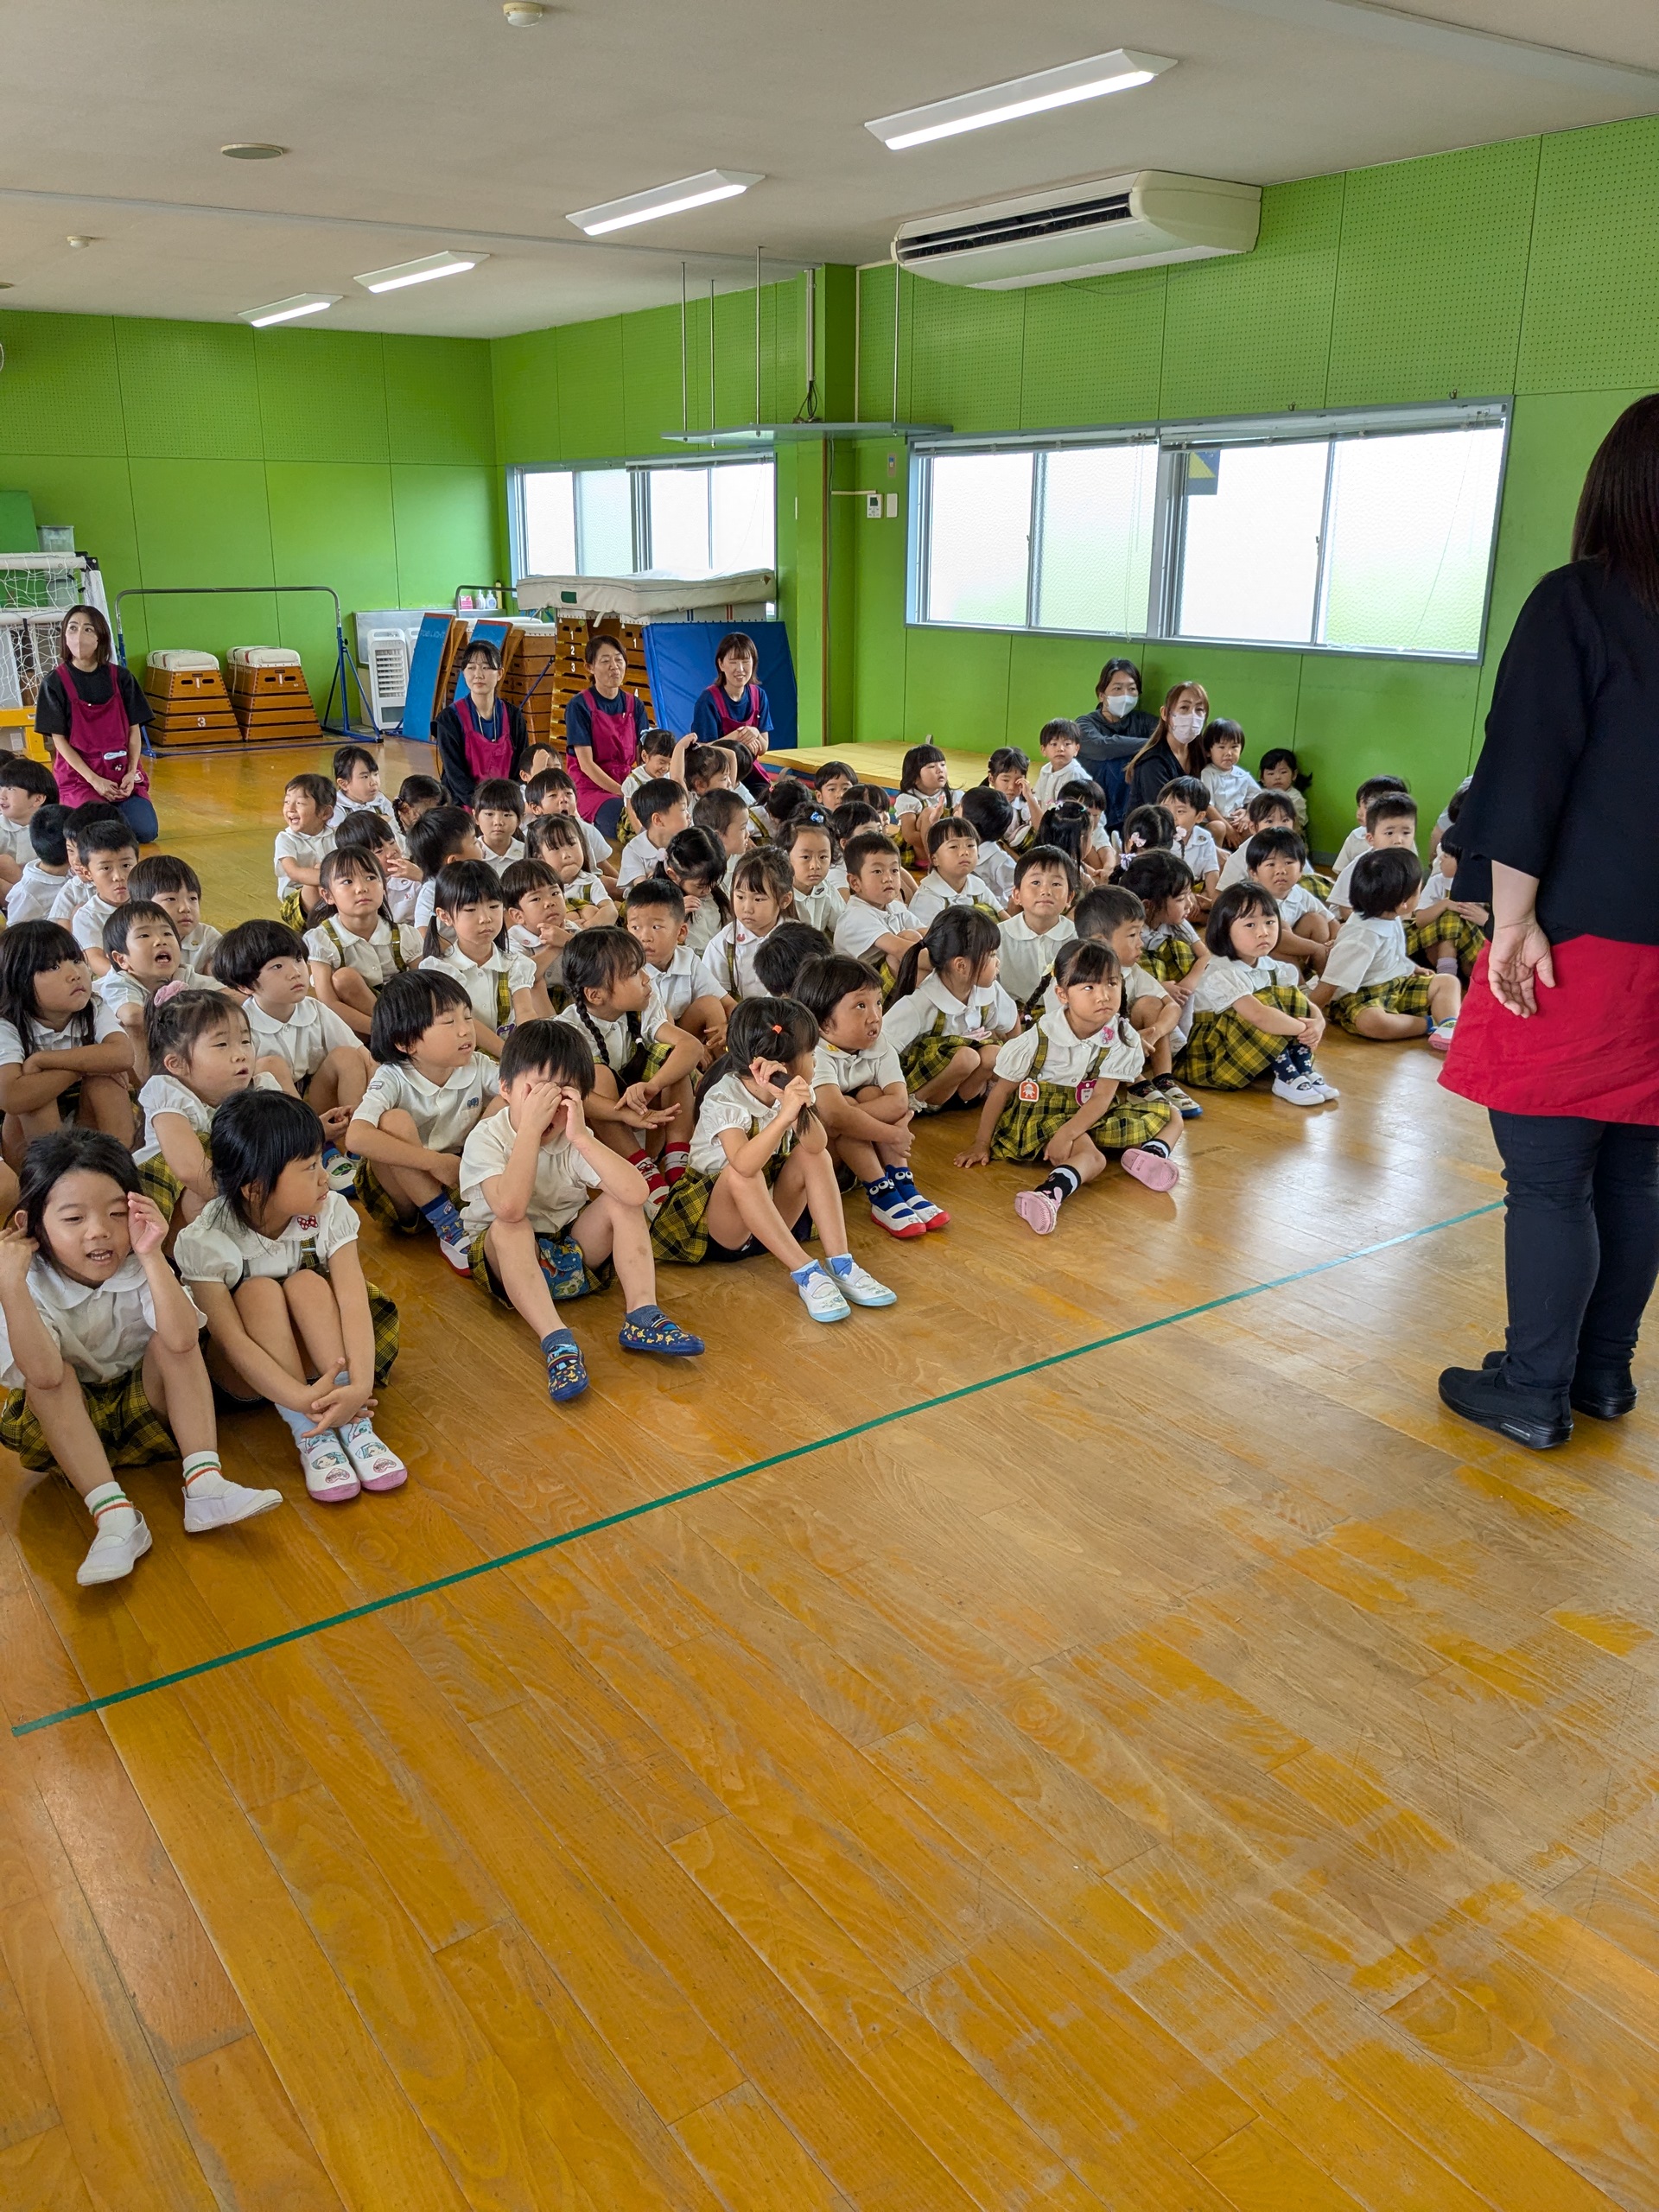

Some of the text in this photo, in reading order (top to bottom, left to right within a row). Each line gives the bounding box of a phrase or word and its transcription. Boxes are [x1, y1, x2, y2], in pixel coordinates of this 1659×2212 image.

[570, 630, 574, 640] 1
[633, 638, 637, 648] 1
[570, 645, 575, 655] 2
[571, 663, 575, 672] 3
[197, 717, 206, 728] 3
